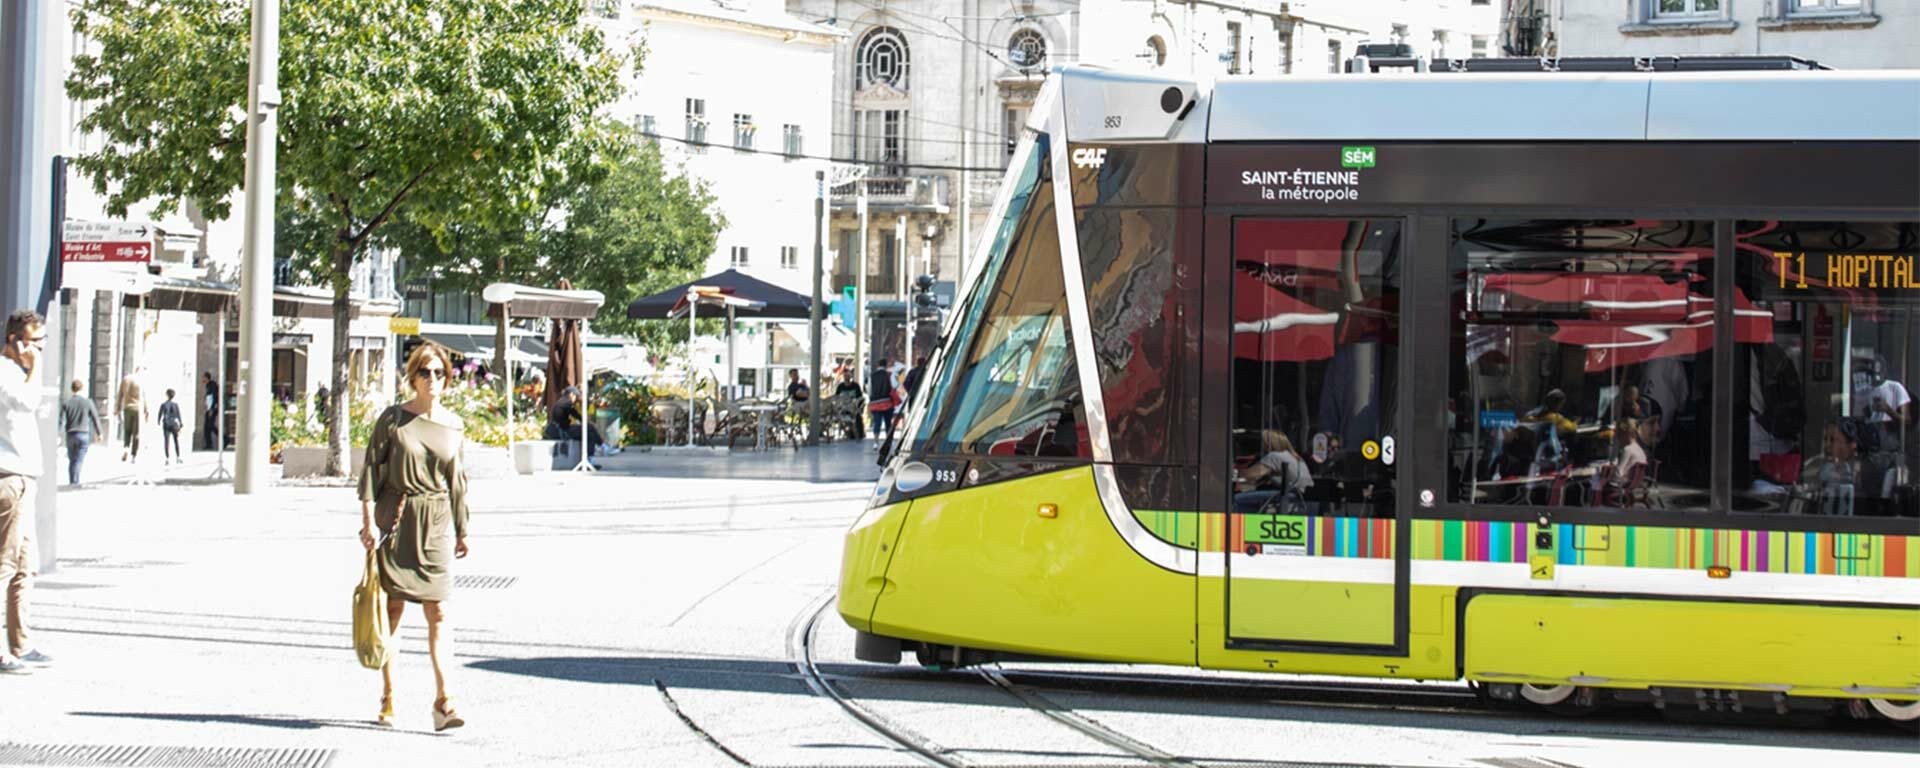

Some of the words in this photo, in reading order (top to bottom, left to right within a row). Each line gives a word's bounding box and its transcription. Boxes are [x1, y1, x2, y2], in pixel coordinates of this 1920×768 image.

[1104, 115, 1122, 129] 953
[1072, 148, 1107, 168] CAF
[1344, 147, 1374, 163] SÉM
[1241, 167, 1359, 185] SAINT-ÉTIENNE
[1261, 186, 1275, 200] la
[1278, 185, 1359, 203] métropole
[1773, 252, 1808, 289] T1
[1826, 254, 1920, 289] HOPITAL
[935, 470, 957, 483] 953
[1260, 514, 1303, 540] stas
